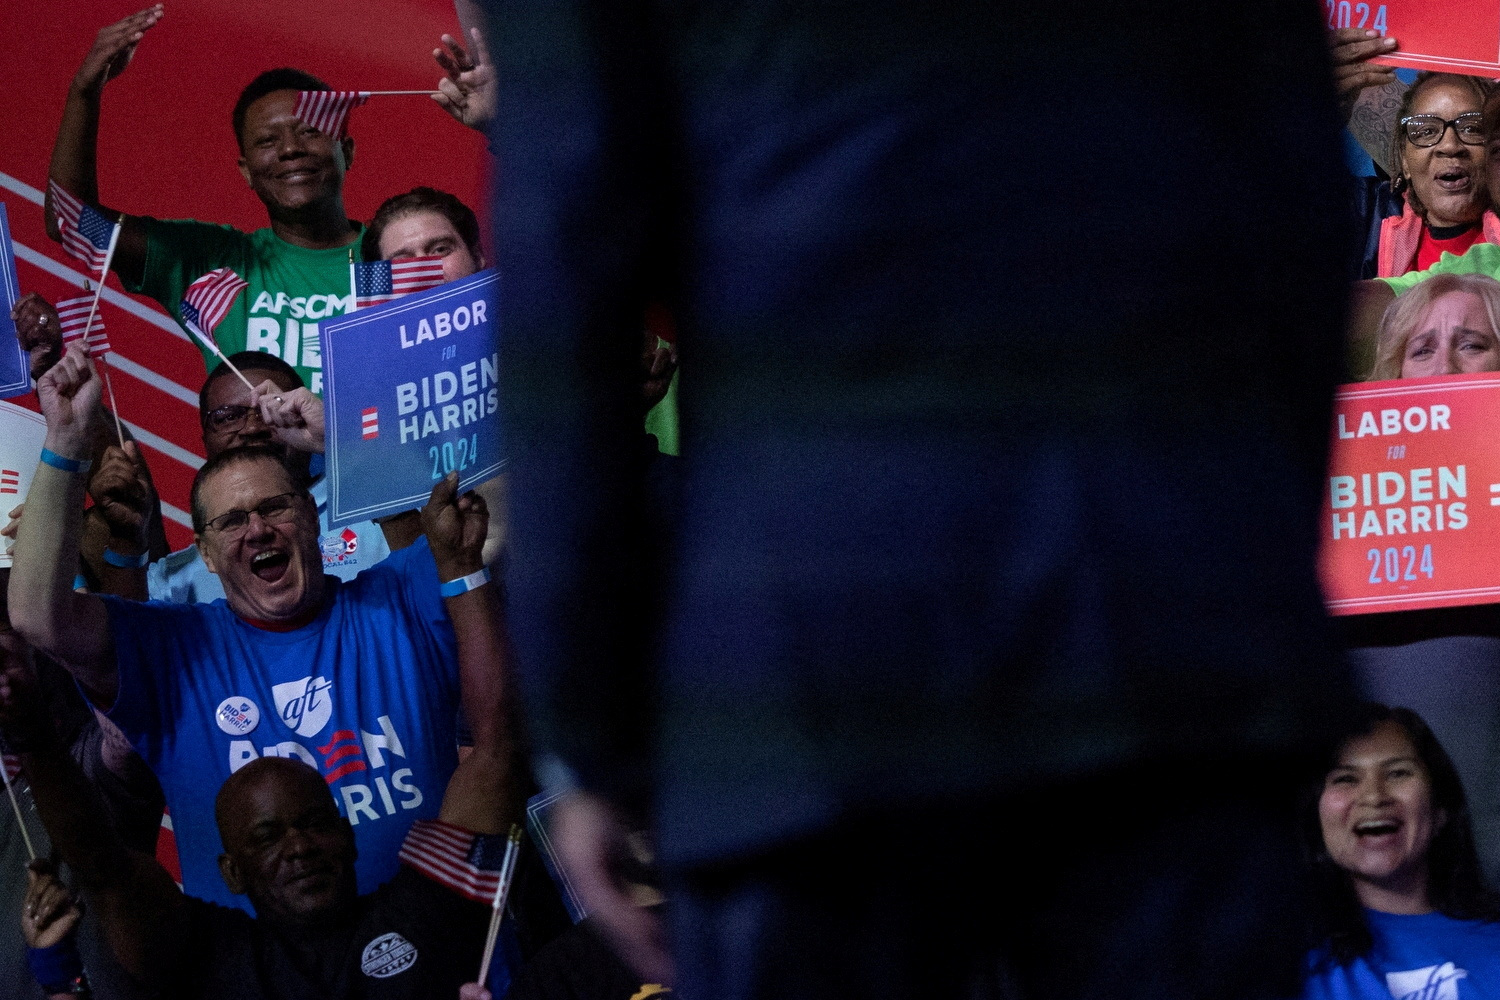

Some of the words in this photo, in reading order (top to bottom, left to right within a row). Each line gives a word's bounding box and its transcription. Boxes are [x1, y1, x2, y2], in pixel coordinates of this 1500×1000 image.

[400, 300, 487, 349] LABOR
[441, 344, 457, 361] FOR
[396, 353, 499, 416] BIDEN
[400, 387, 499, 444] HARRIS
[1338, 404, 1451, 440] LABOR
[429, 433, 478, 480] 2024
[1386, 445, 1406, 460] FOR
[1330, 464, 1467, 509] BIDEN
[1332, 501, 1468, 540] HARRIS
[1367, 543, 1434, 584] 2024
[224, 703, 252, 727] BIDEN
[282, 676, 332, 732] aft
